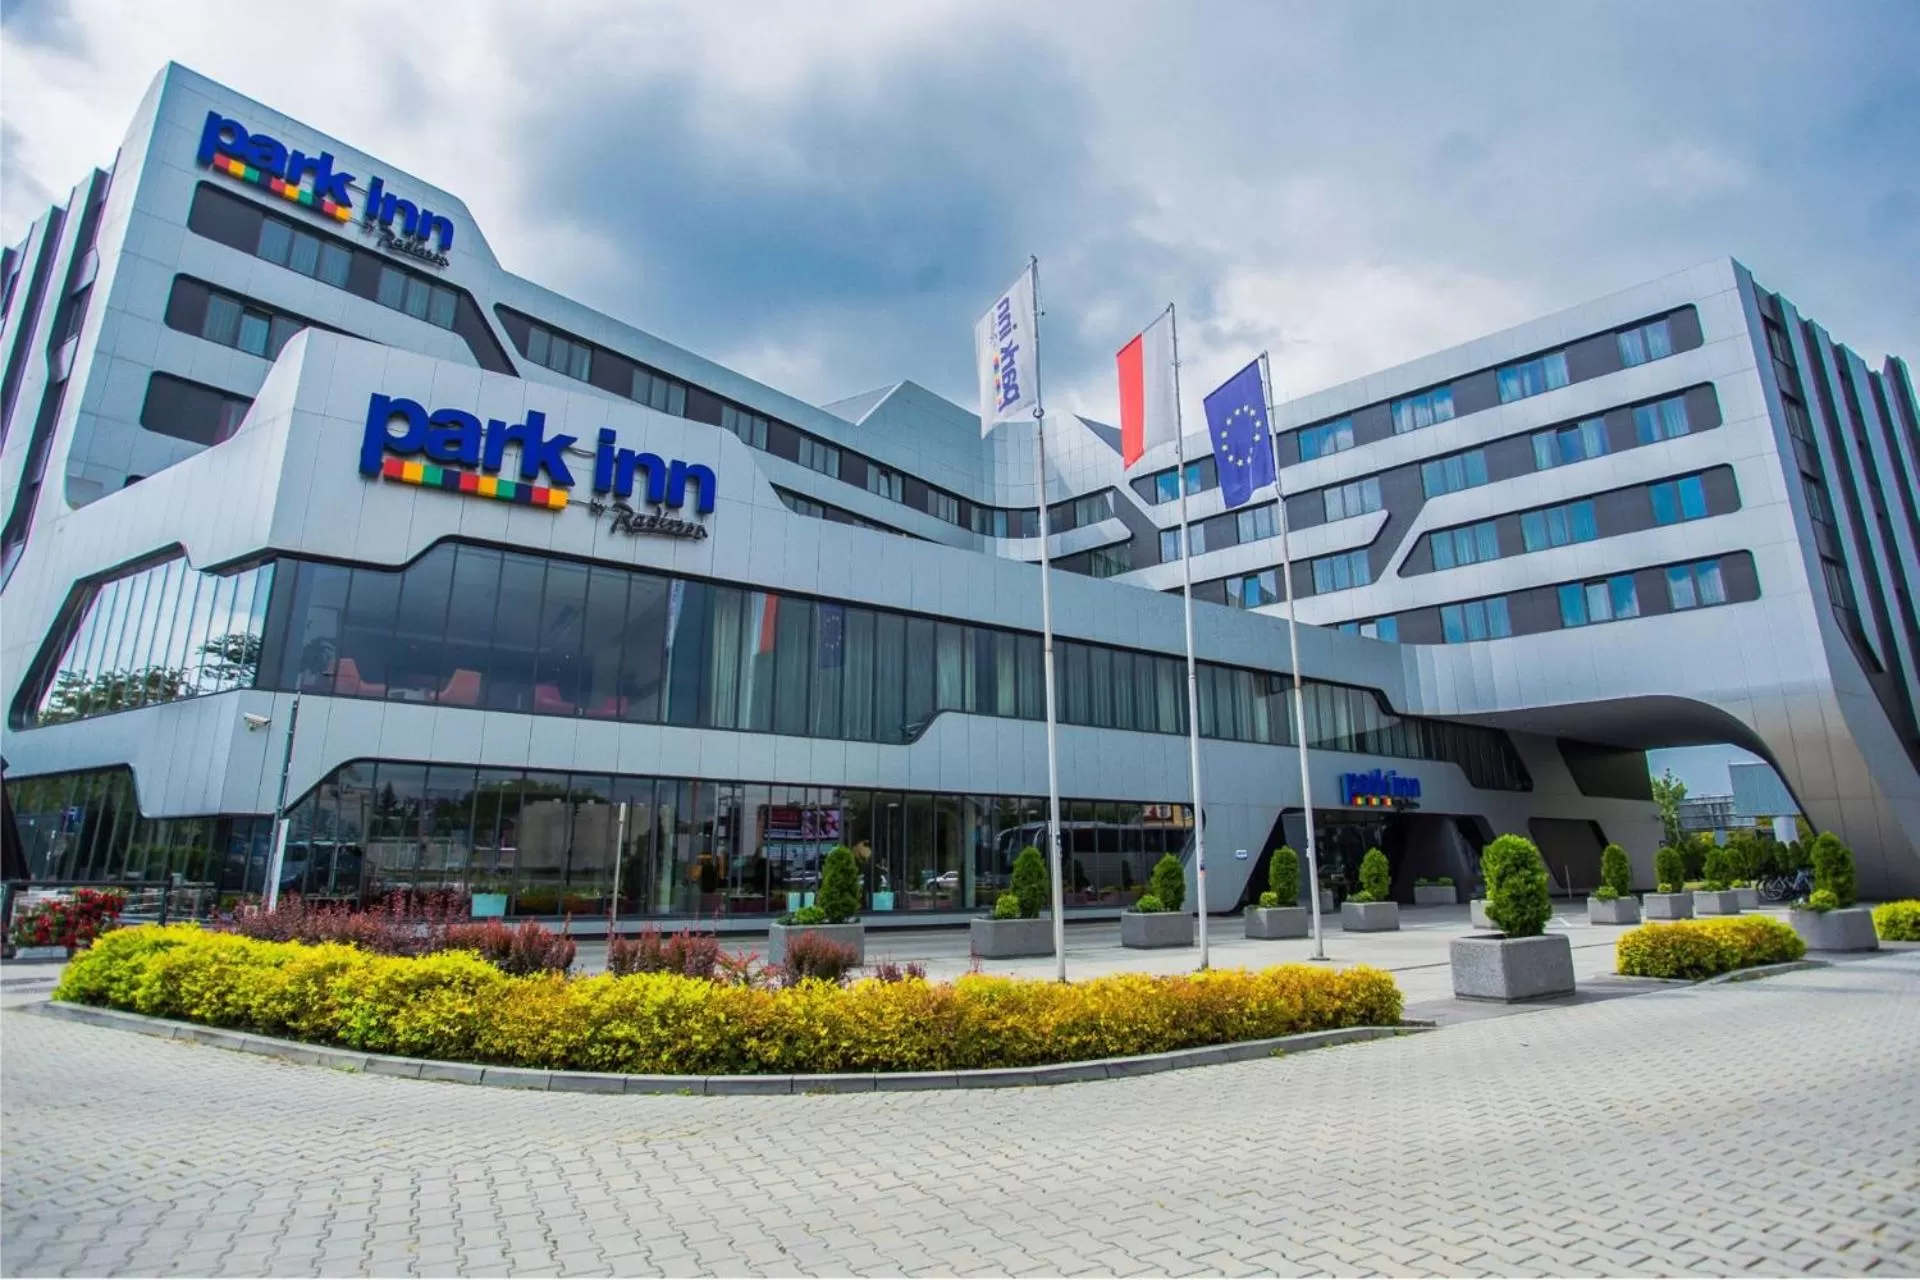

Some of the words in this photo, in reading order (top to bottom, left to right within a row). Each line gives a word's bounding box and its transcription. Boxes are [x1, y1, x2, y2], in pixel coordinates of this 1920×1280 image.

[196, 110, 356, 207] park
[364, 175, 455, 252] inn
[359, 392, 578, 487] park
[595, 428, 716, 514] inn
[1386, 770, 1421, 798] inn
